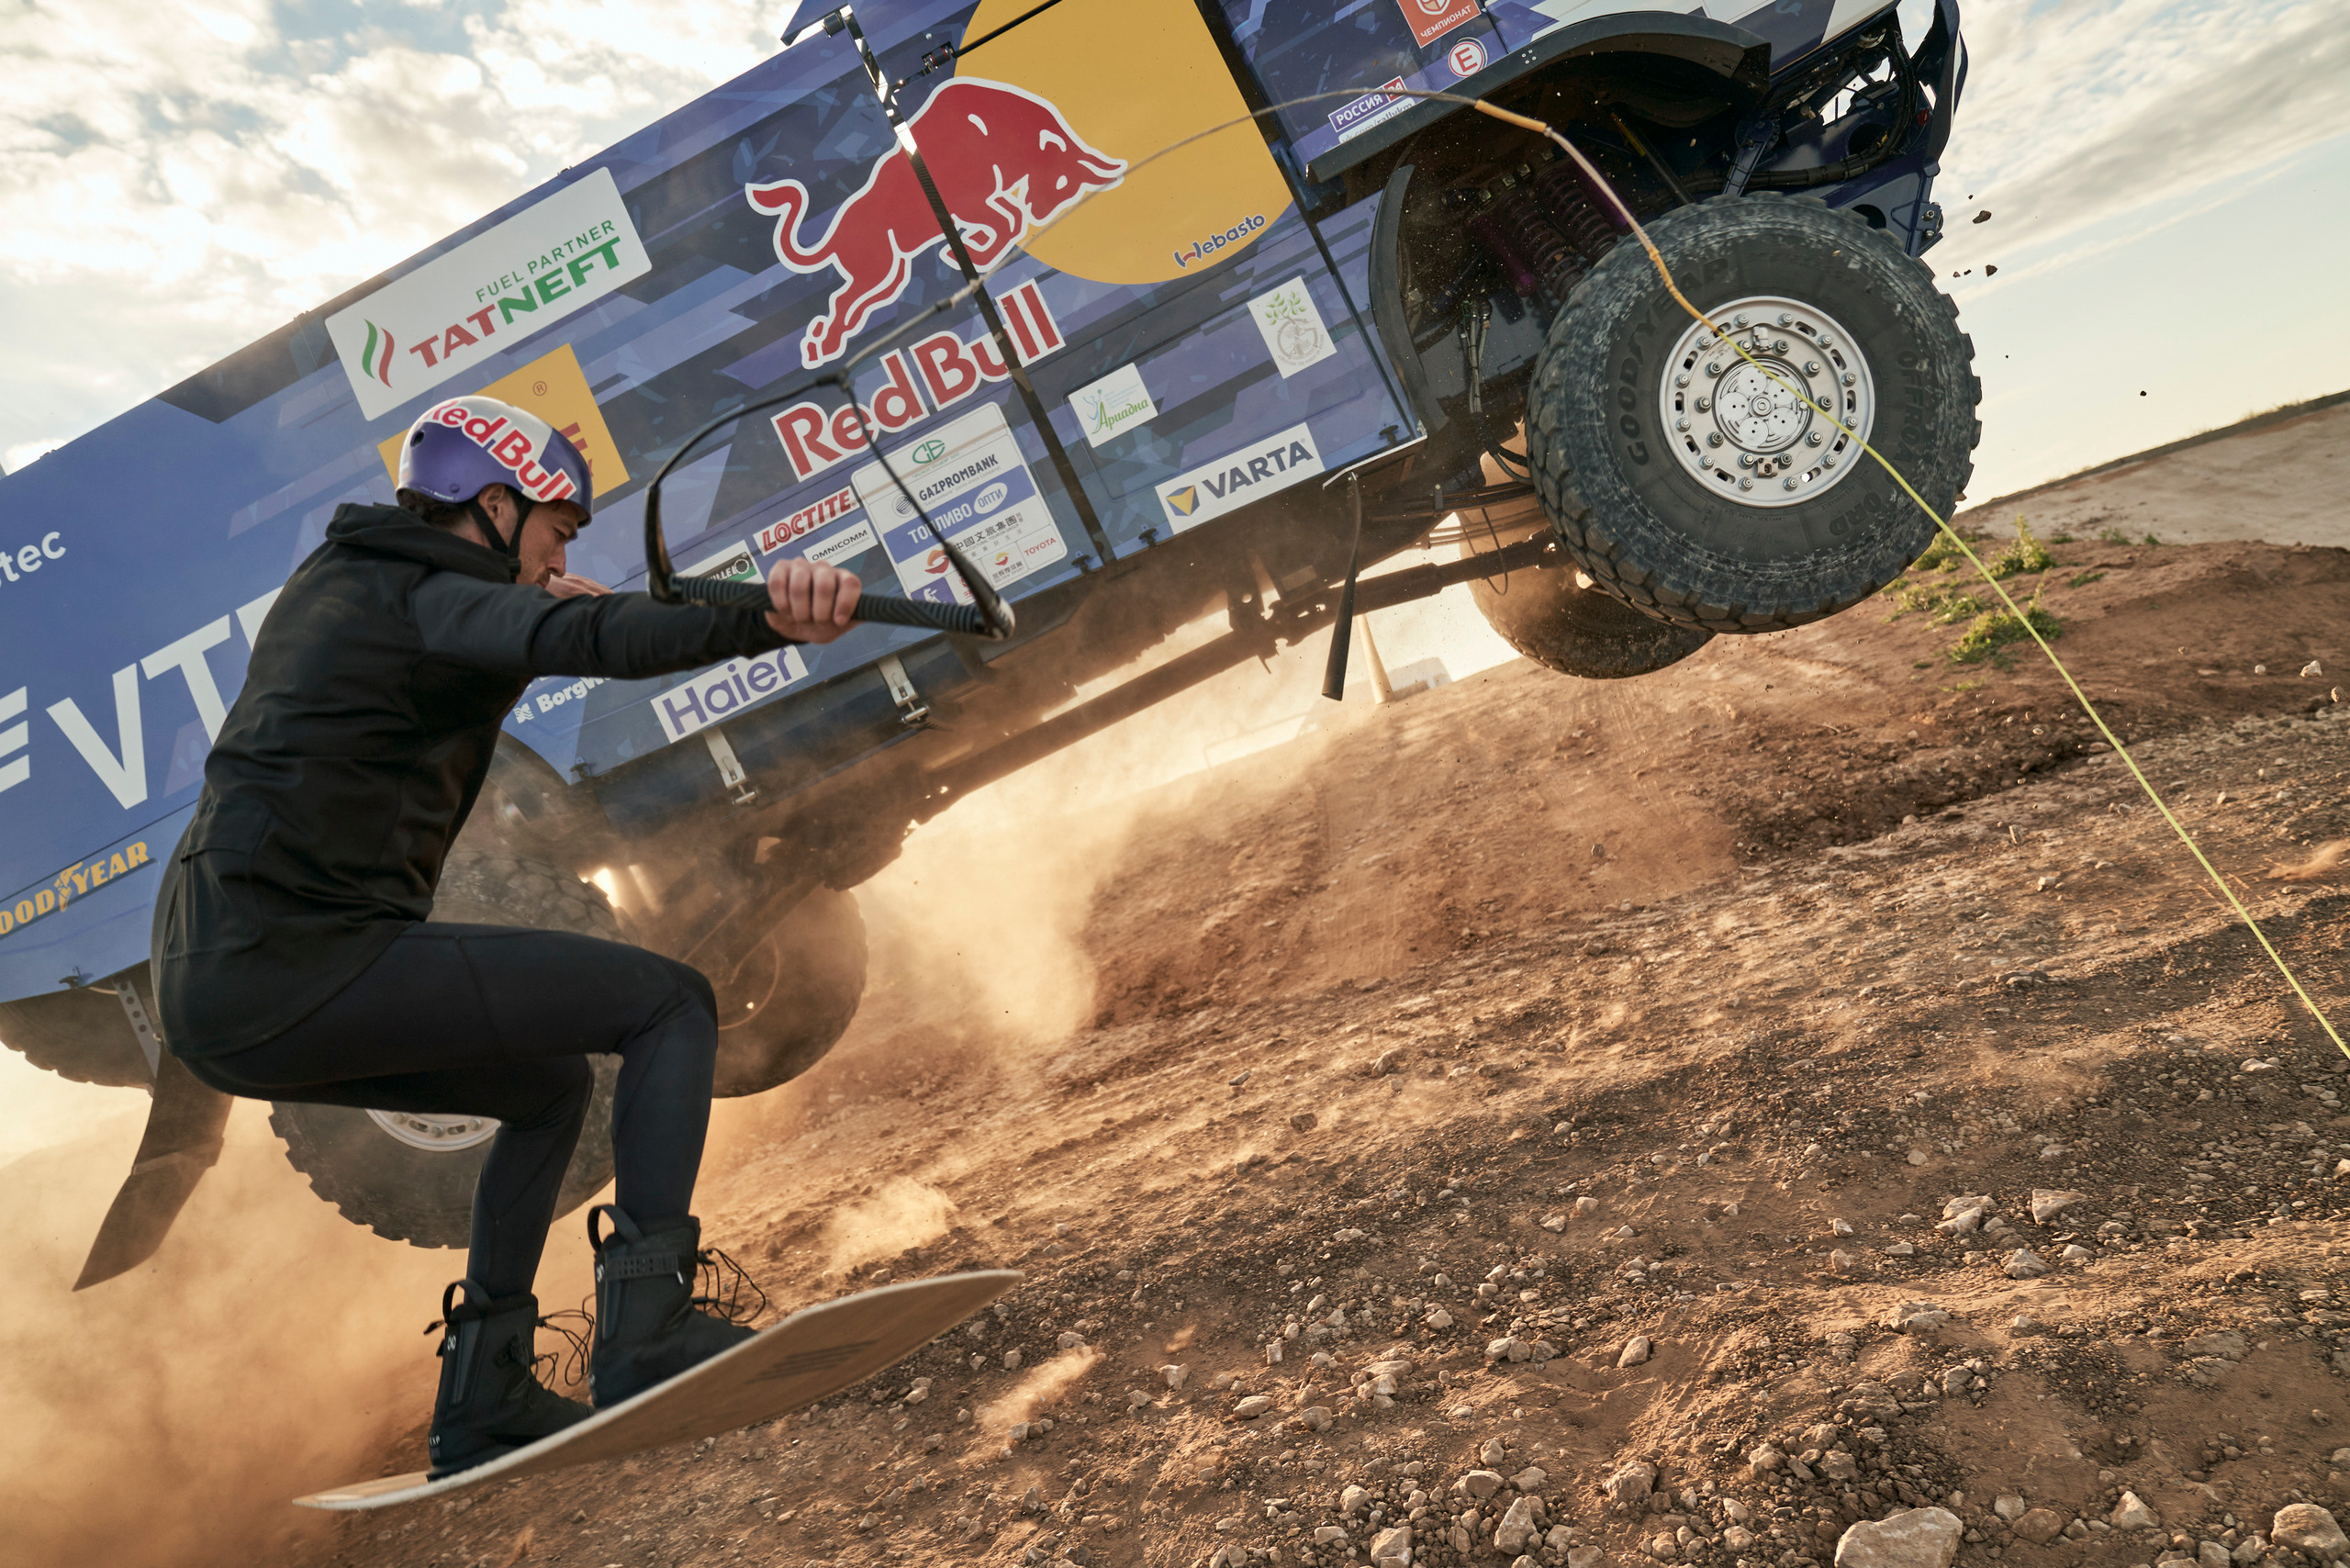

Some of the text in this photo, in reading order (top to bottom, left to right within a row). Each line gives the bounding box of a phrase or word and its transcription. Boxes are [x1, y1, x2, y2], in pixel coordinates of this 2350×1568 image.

[1420, 5, 1472, 38] ЧЕМПИОНАТ
[1336, 94, 1383, 126] РОССИЯ
[476, 219, 616, 303] FUEL PARTNER
[1173, 214, 1266, 268] Webasto
[408, 235, 621, 368] TATNEFT
[776, 284, 1059, 476] Red Bull
[1617, 258, 1729, 466] GOODYEAR
[1091, 398, 1149, 435] Ариадна
[491, 429, 574, 500] Bull
[919, 454, 999, 501] GAZPROMBANK
[1202, 441, 1314, 499] VARTA
[762, 489, 852, 552] LOCTITE
[907, 488, 1003, 544] ТОПЛИВО ОПТИ
[0, 531, 66, 588] tec
[811, 530, 868, 561] OMNICOMM
[1024, 537, 1057, 557] TOYOTA
[46, 585, 285, 810] VT
[535, 677, 611, 713] BorgW
[662, 647, 792, 736] Haier
